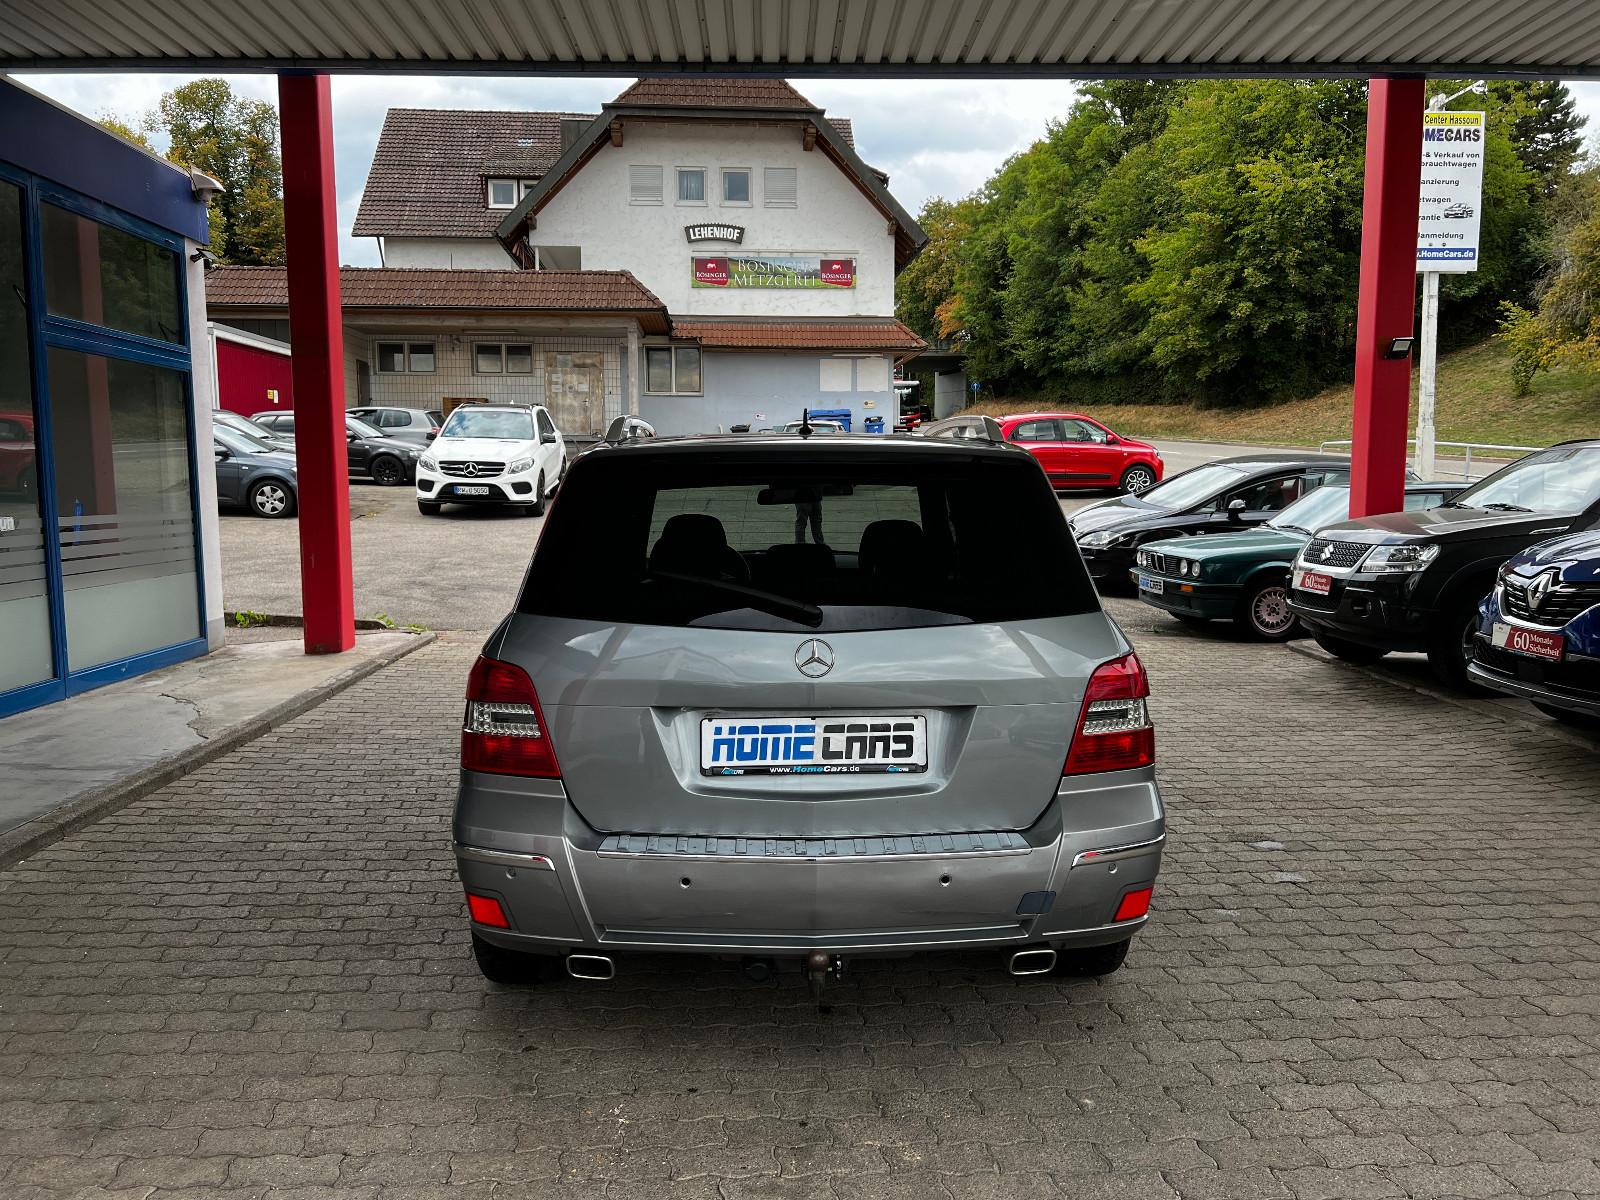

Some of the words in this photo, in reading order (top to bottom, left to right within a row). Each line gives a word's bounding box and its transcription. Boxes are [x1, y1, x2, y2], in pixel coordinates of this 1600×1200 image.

[1424, 114, 1448, 124] Center
[1449, 115, 1479, 125] Hassoun
[1422, 128, 1481, 142] MECARS
[689, 226, 741, 240] LEHENHOF
[734, 273, 815, 287] METZGEREI
[1305, 575, 1314, 588] 60
[1514, 632, 1529, 650] 60
[1529, 633, 1553, 646] Monate
[712, 724, 816, 762] HOME
[821, 722, 915, 761] CARS
[769, 765, 860, 774] www.HomeCars.de
